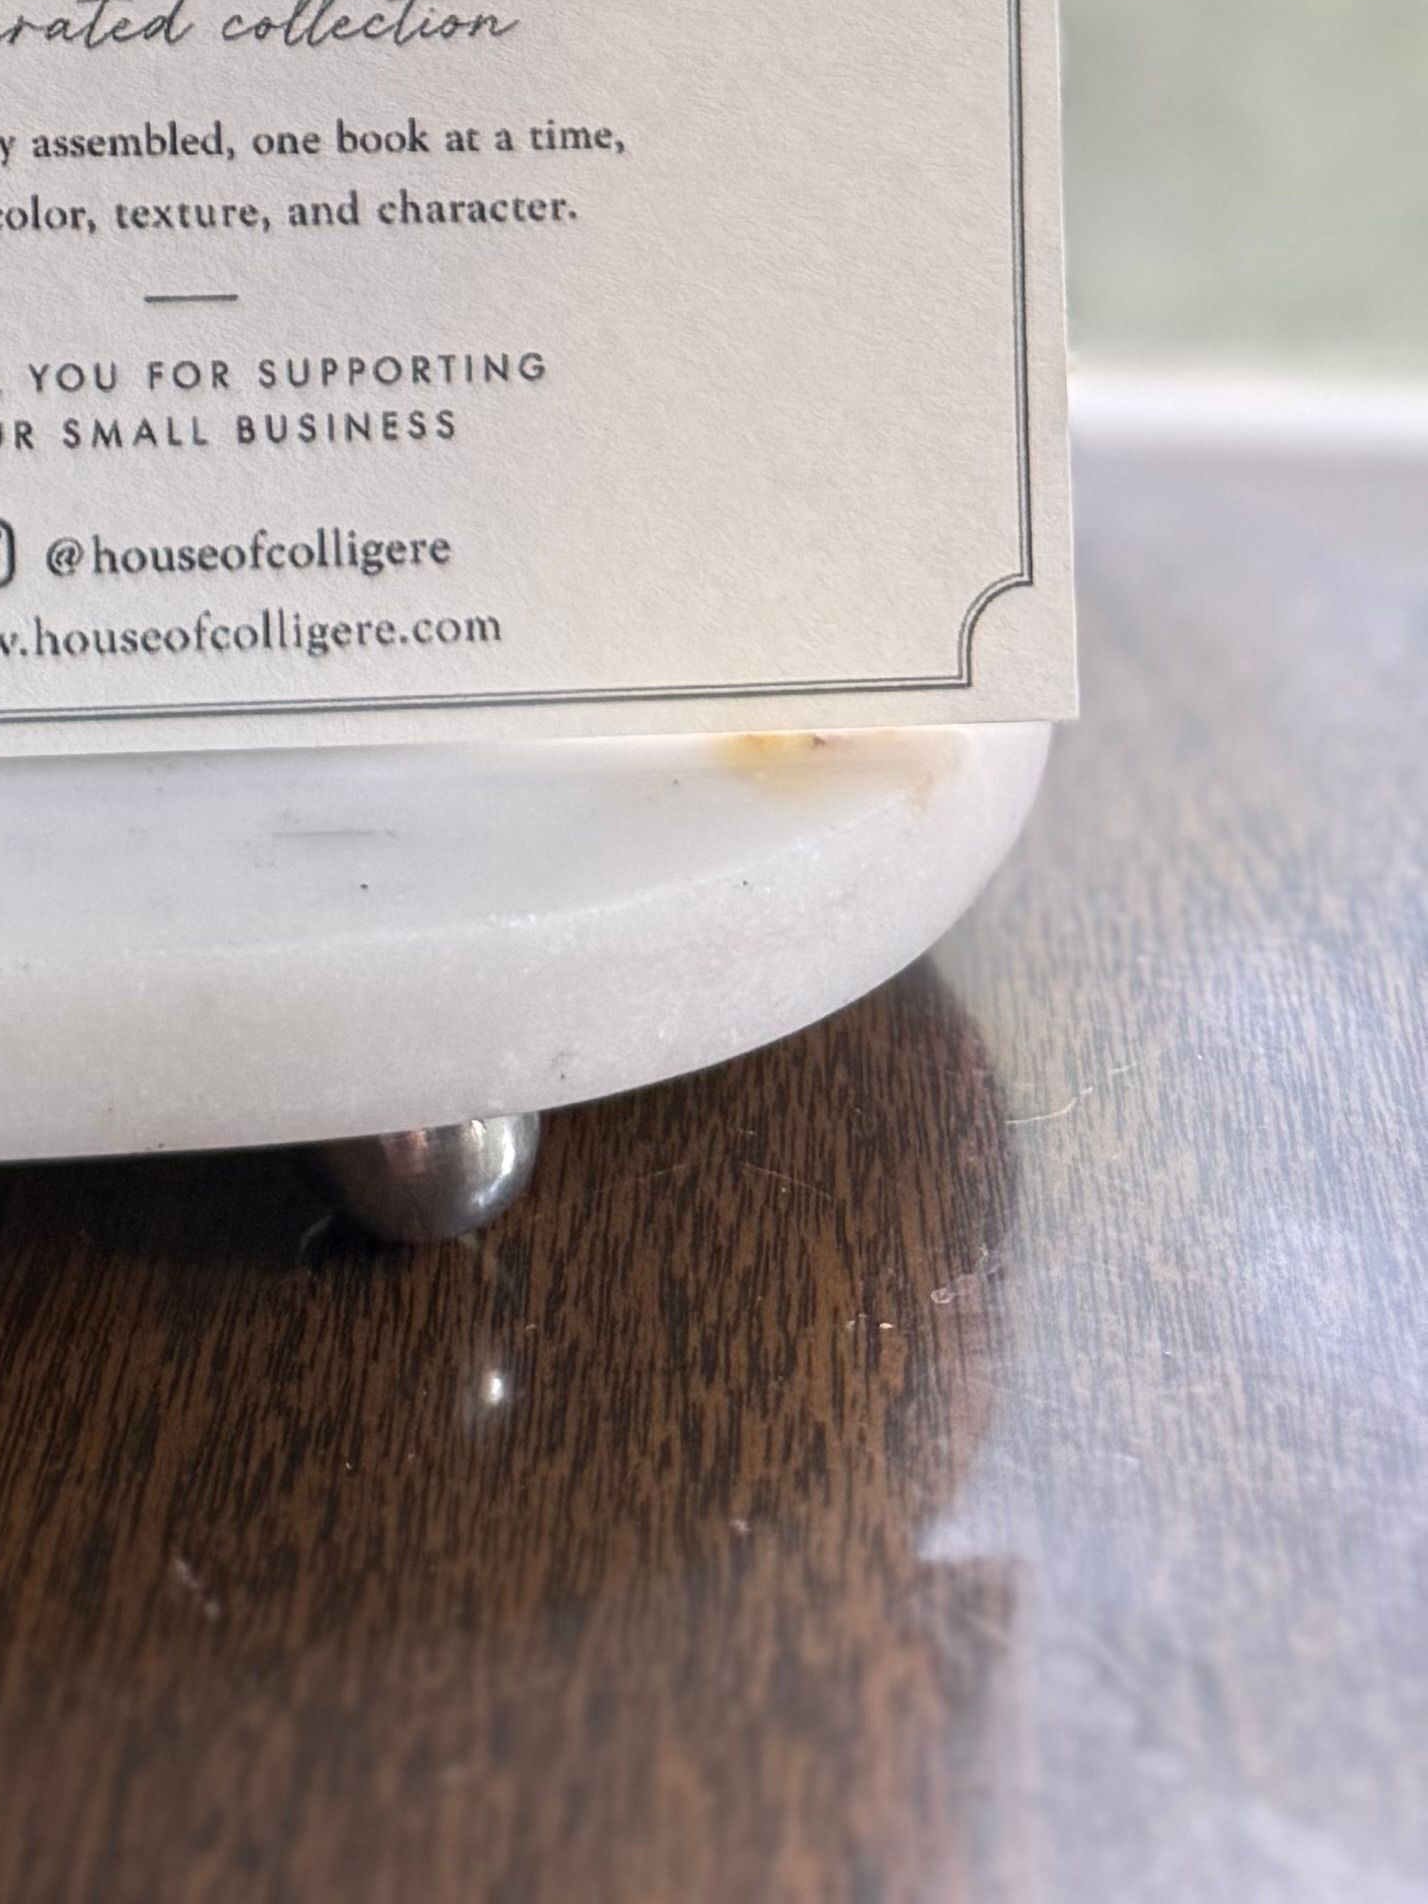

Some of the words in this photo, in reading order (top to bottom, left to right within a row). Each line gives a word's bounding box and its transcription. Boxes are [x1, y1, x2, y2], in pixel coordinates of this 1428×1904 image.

[31, 119, 237, 162] assembled,
[251, 132, 322, 157] one
[335, 116, 431, 155] book
[445, 127, 481, 154] at
[494, 128, 516, 153] a
[529, 121, 625, 157] time,
[114, 200, 273, 233] texture,
[287, 188, 361, 228] and
[376, 187, 578, 227] character.
[28, 362, 119, 394] YOU
[146, 359, 230, 392] FOR
[257, 351, 547, 391] SUPPORTING
[62, 416, 209, 451] SMALL
[235, 408, 457, 447] BUSINESS
[45, 526, 452, 579] @houseofcolligere
